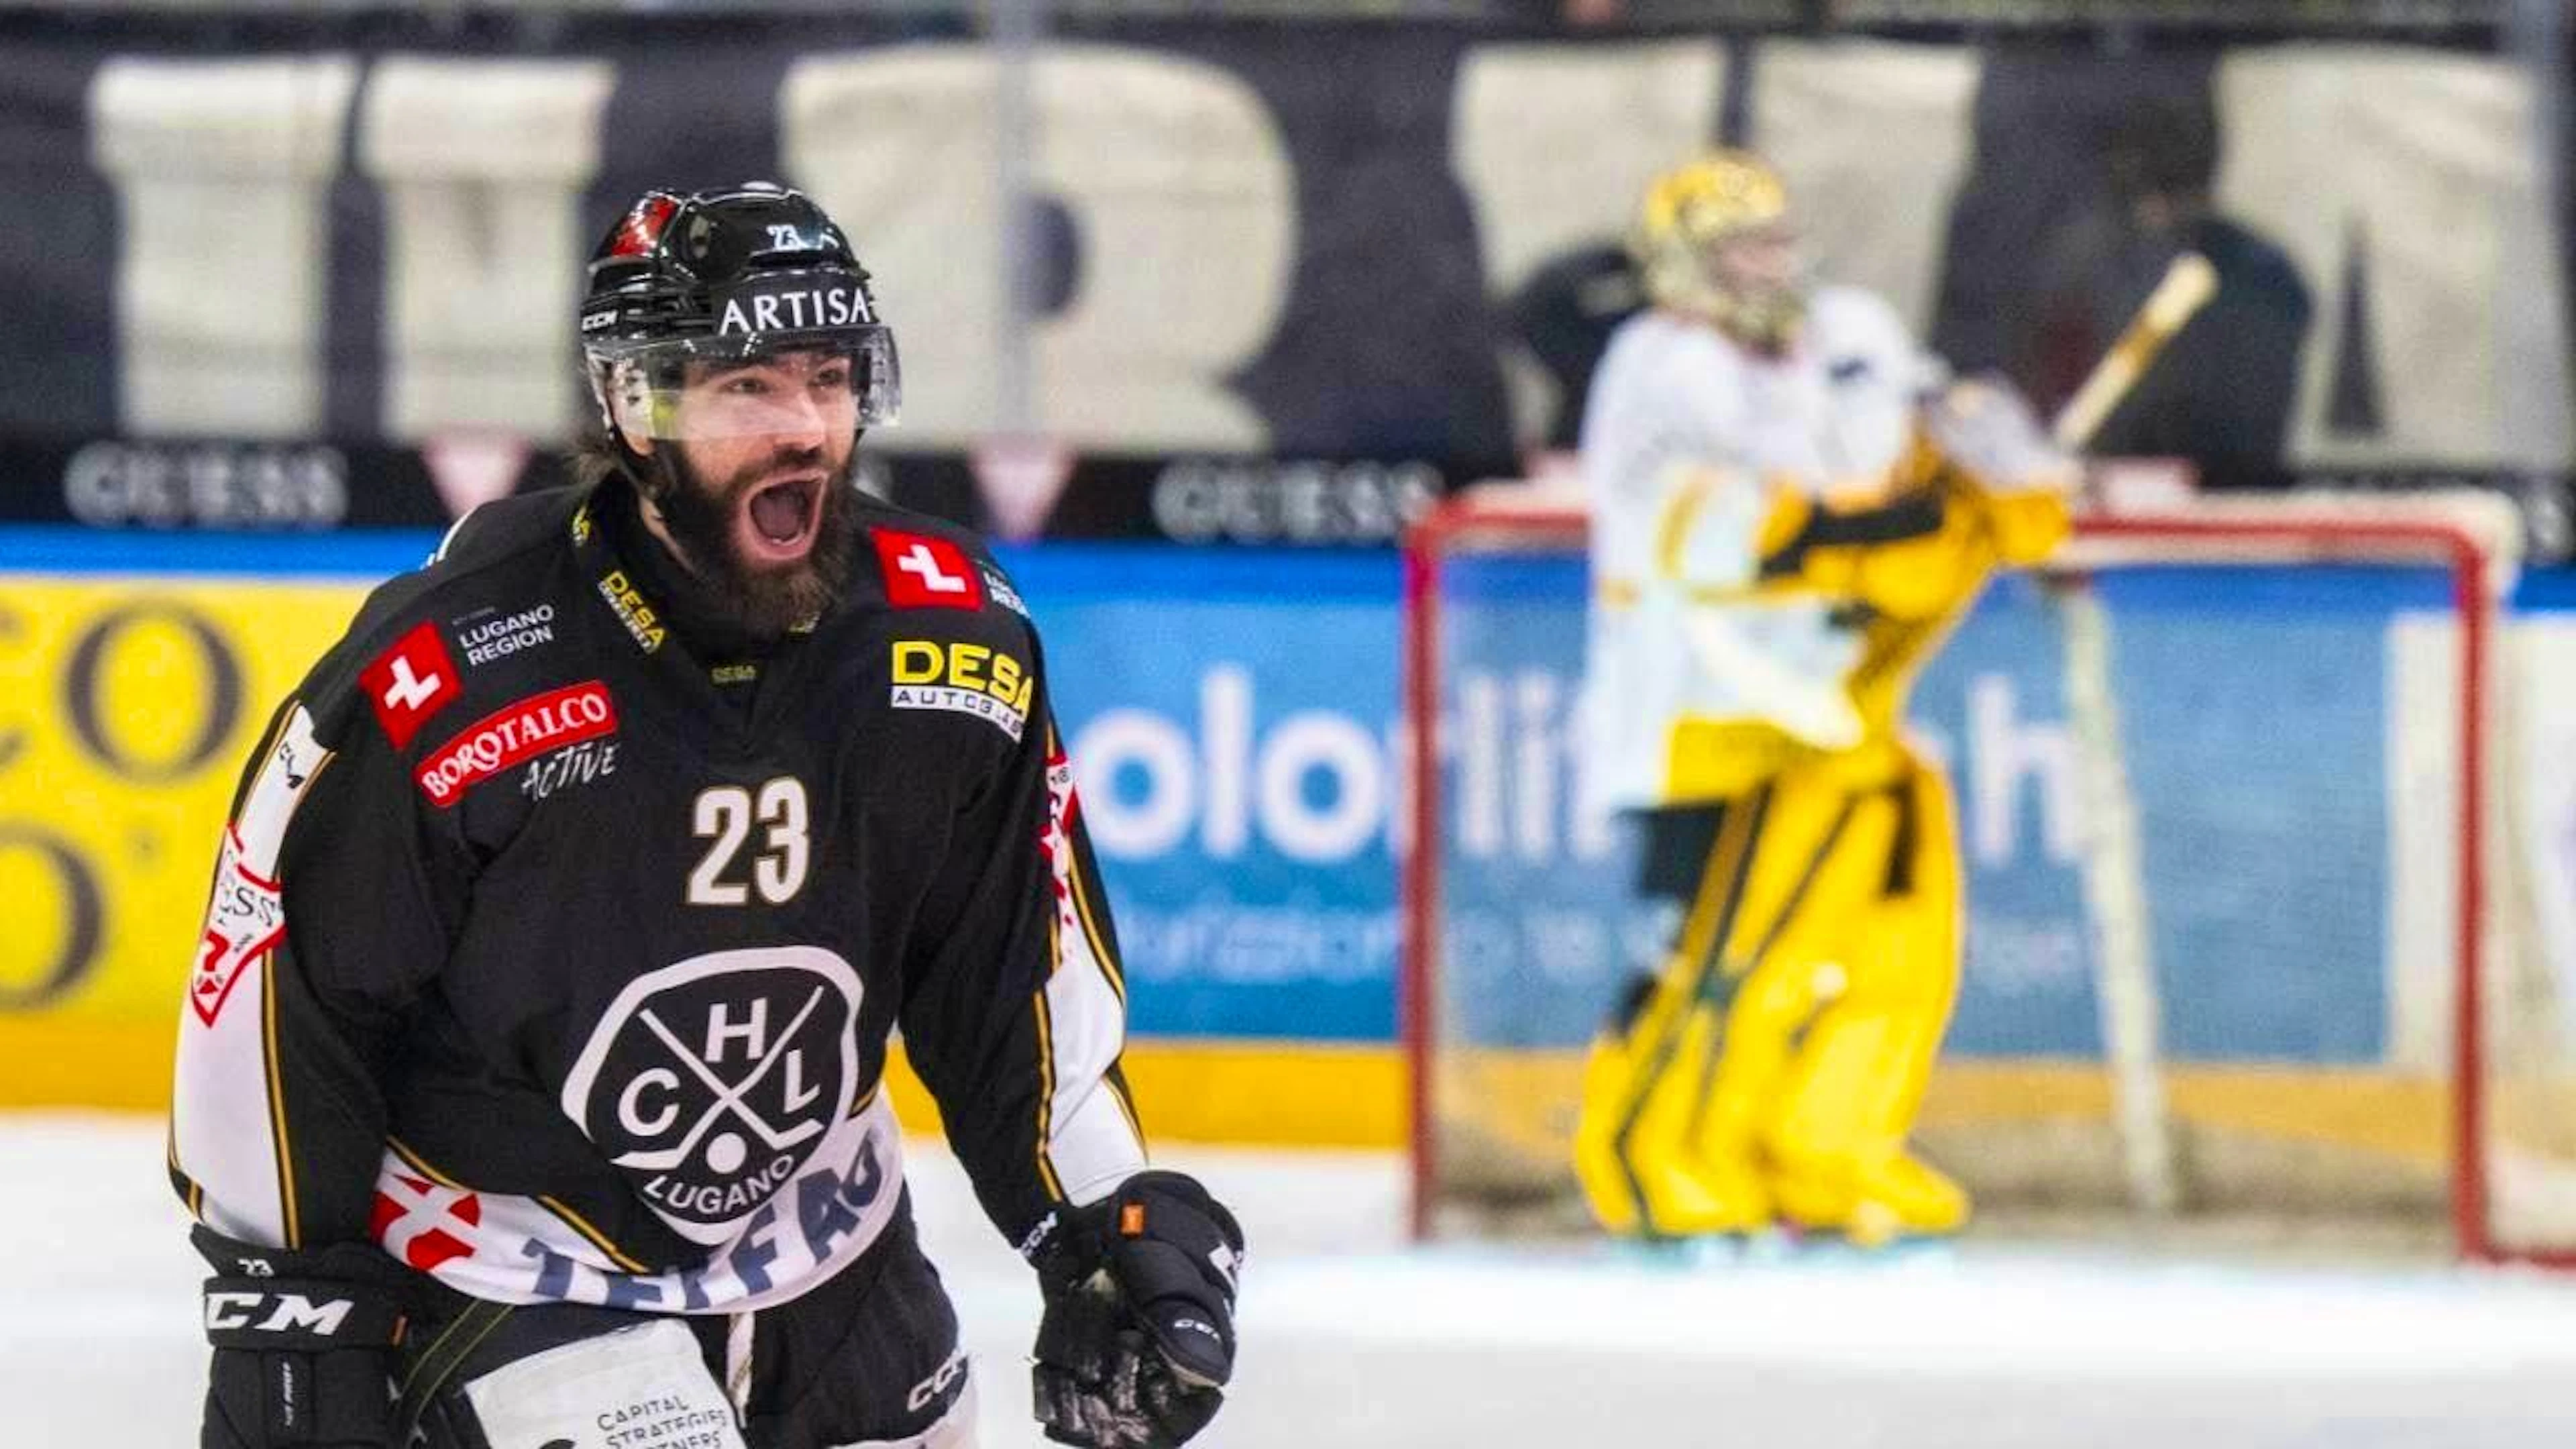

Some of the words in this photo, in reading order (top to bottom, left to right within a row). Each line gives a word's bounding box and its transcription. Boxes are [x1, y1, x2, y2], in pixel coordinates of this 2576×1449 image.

[581, 309, 617, 330] CCM
[460, 604, 554, 649] LUGANO
[607, 570, 665, 647] DESA
[468, 624, 553, 666] REGION
[893, 641, 1034, 722] DESA
[421, 694, 607, 798] BOROTALCO
[521, 742, 623, 800] ACTIVE
[687, 778, 811, 905] 23
[643, 1155, 794, 1215] LUGANO
[597, 1395, 689, 1431] CAPITAL
